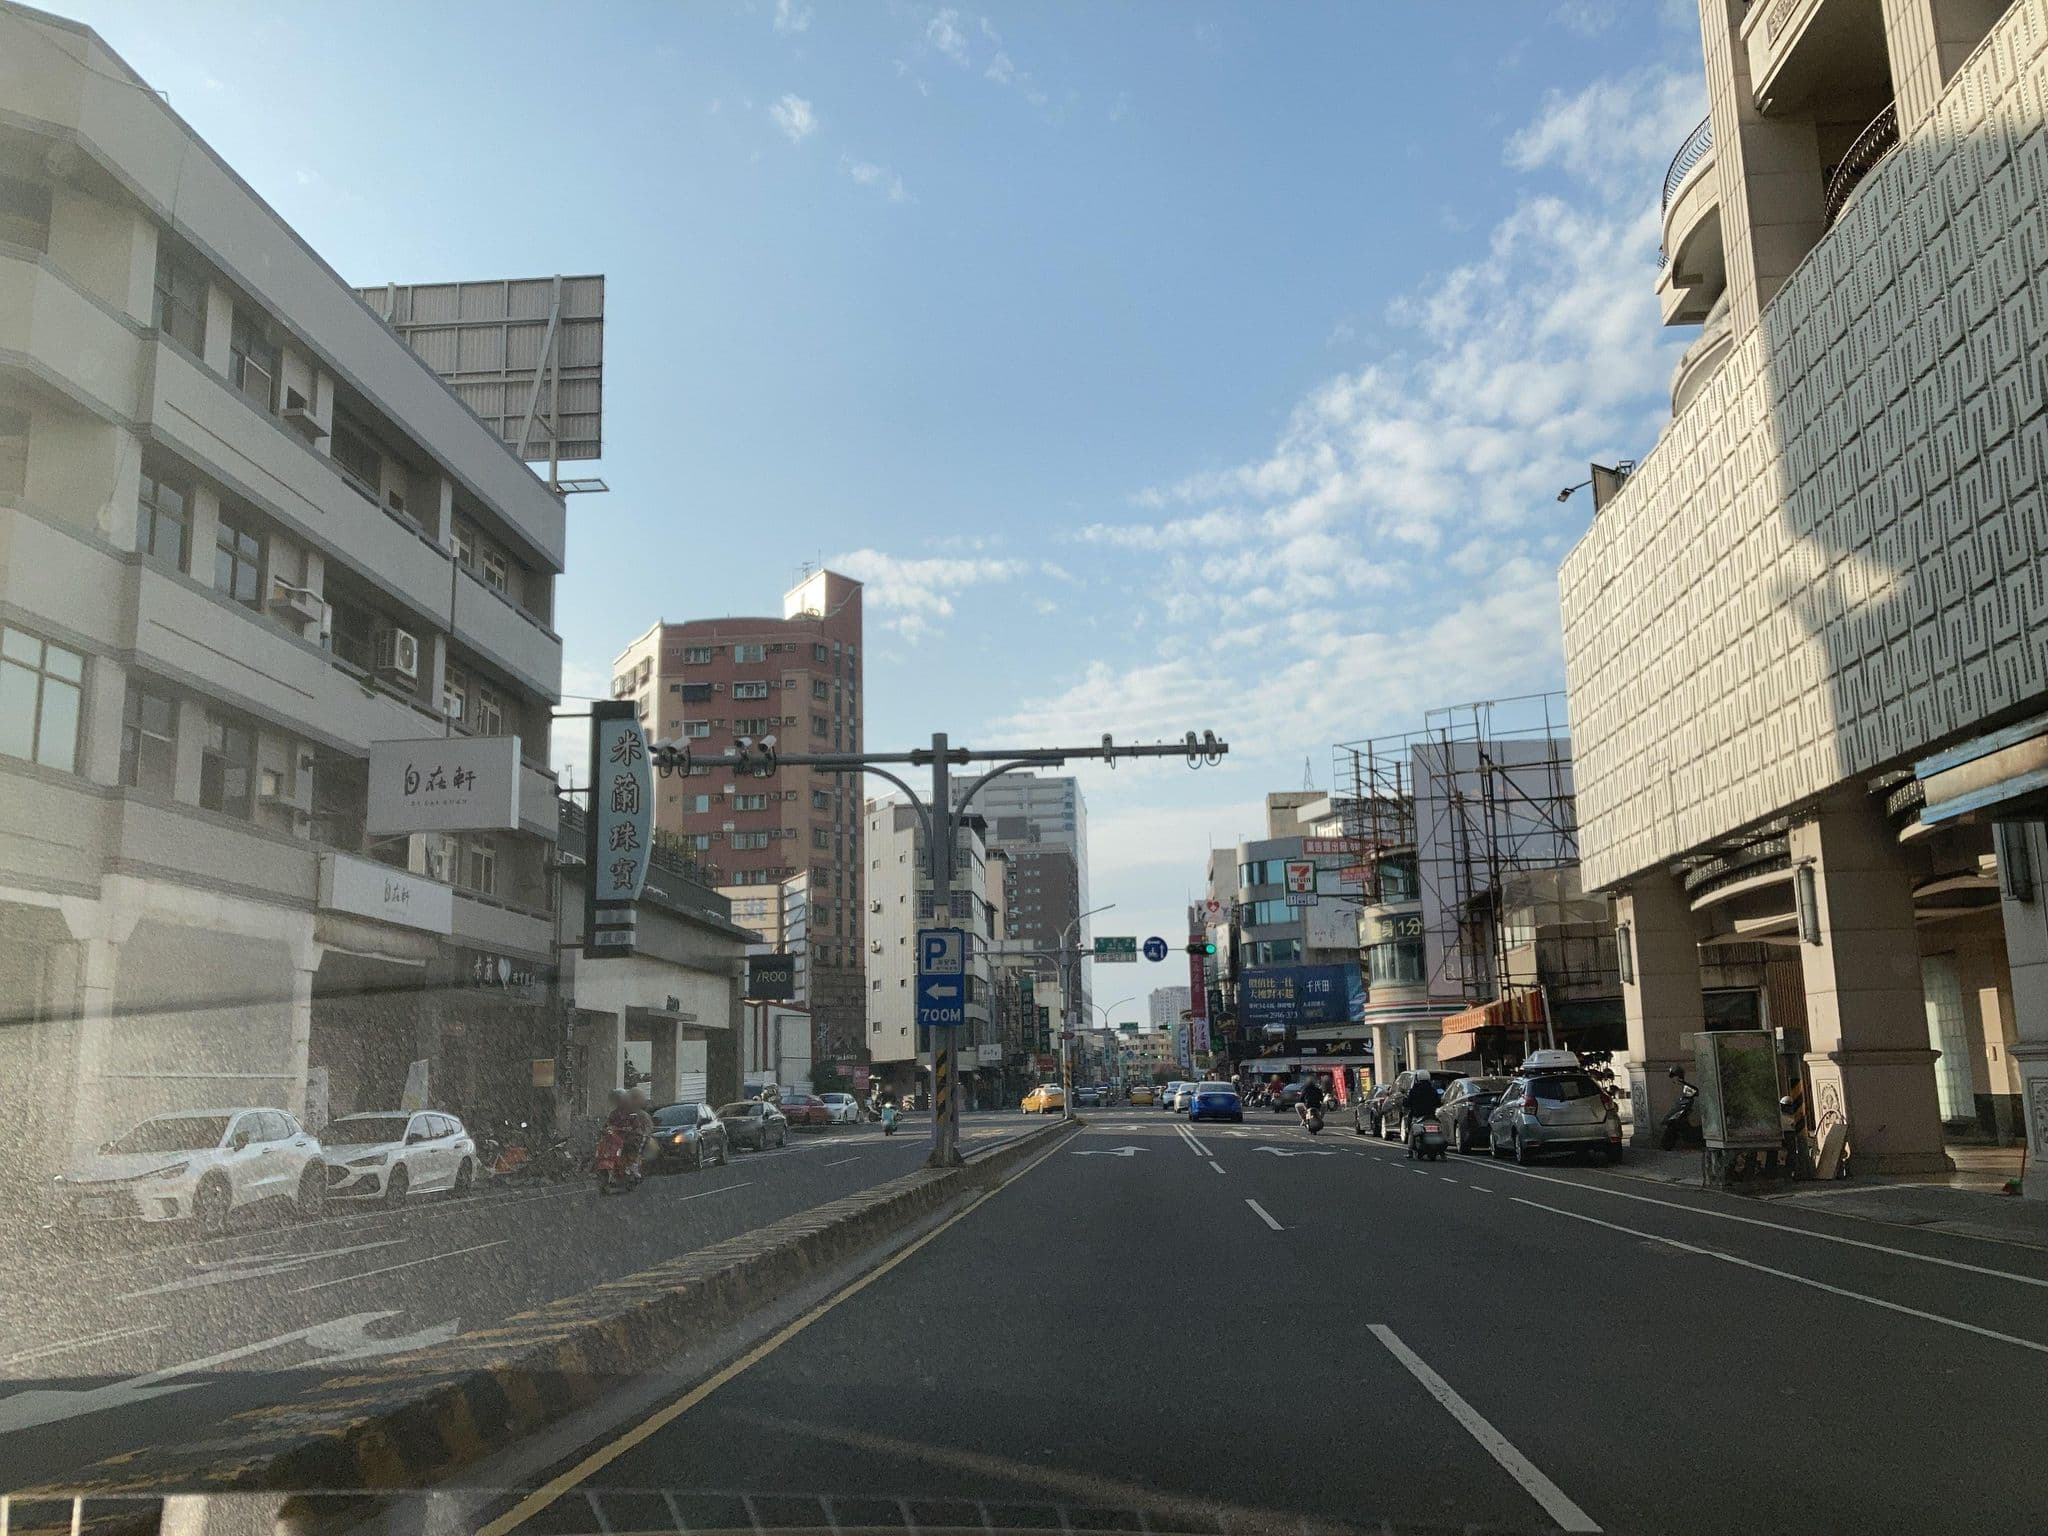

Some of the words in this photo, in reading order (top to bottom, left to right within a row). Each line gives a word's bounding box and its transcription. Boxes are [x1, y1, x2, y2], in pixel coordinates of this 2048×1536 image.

[404, 763, 476, 796] 自在軒
[610, 728, 642, 890] 米蘭珠寶
[1306, 979, 1330, 993] 千代田
[920, 1008, 961, 1022] 700M
